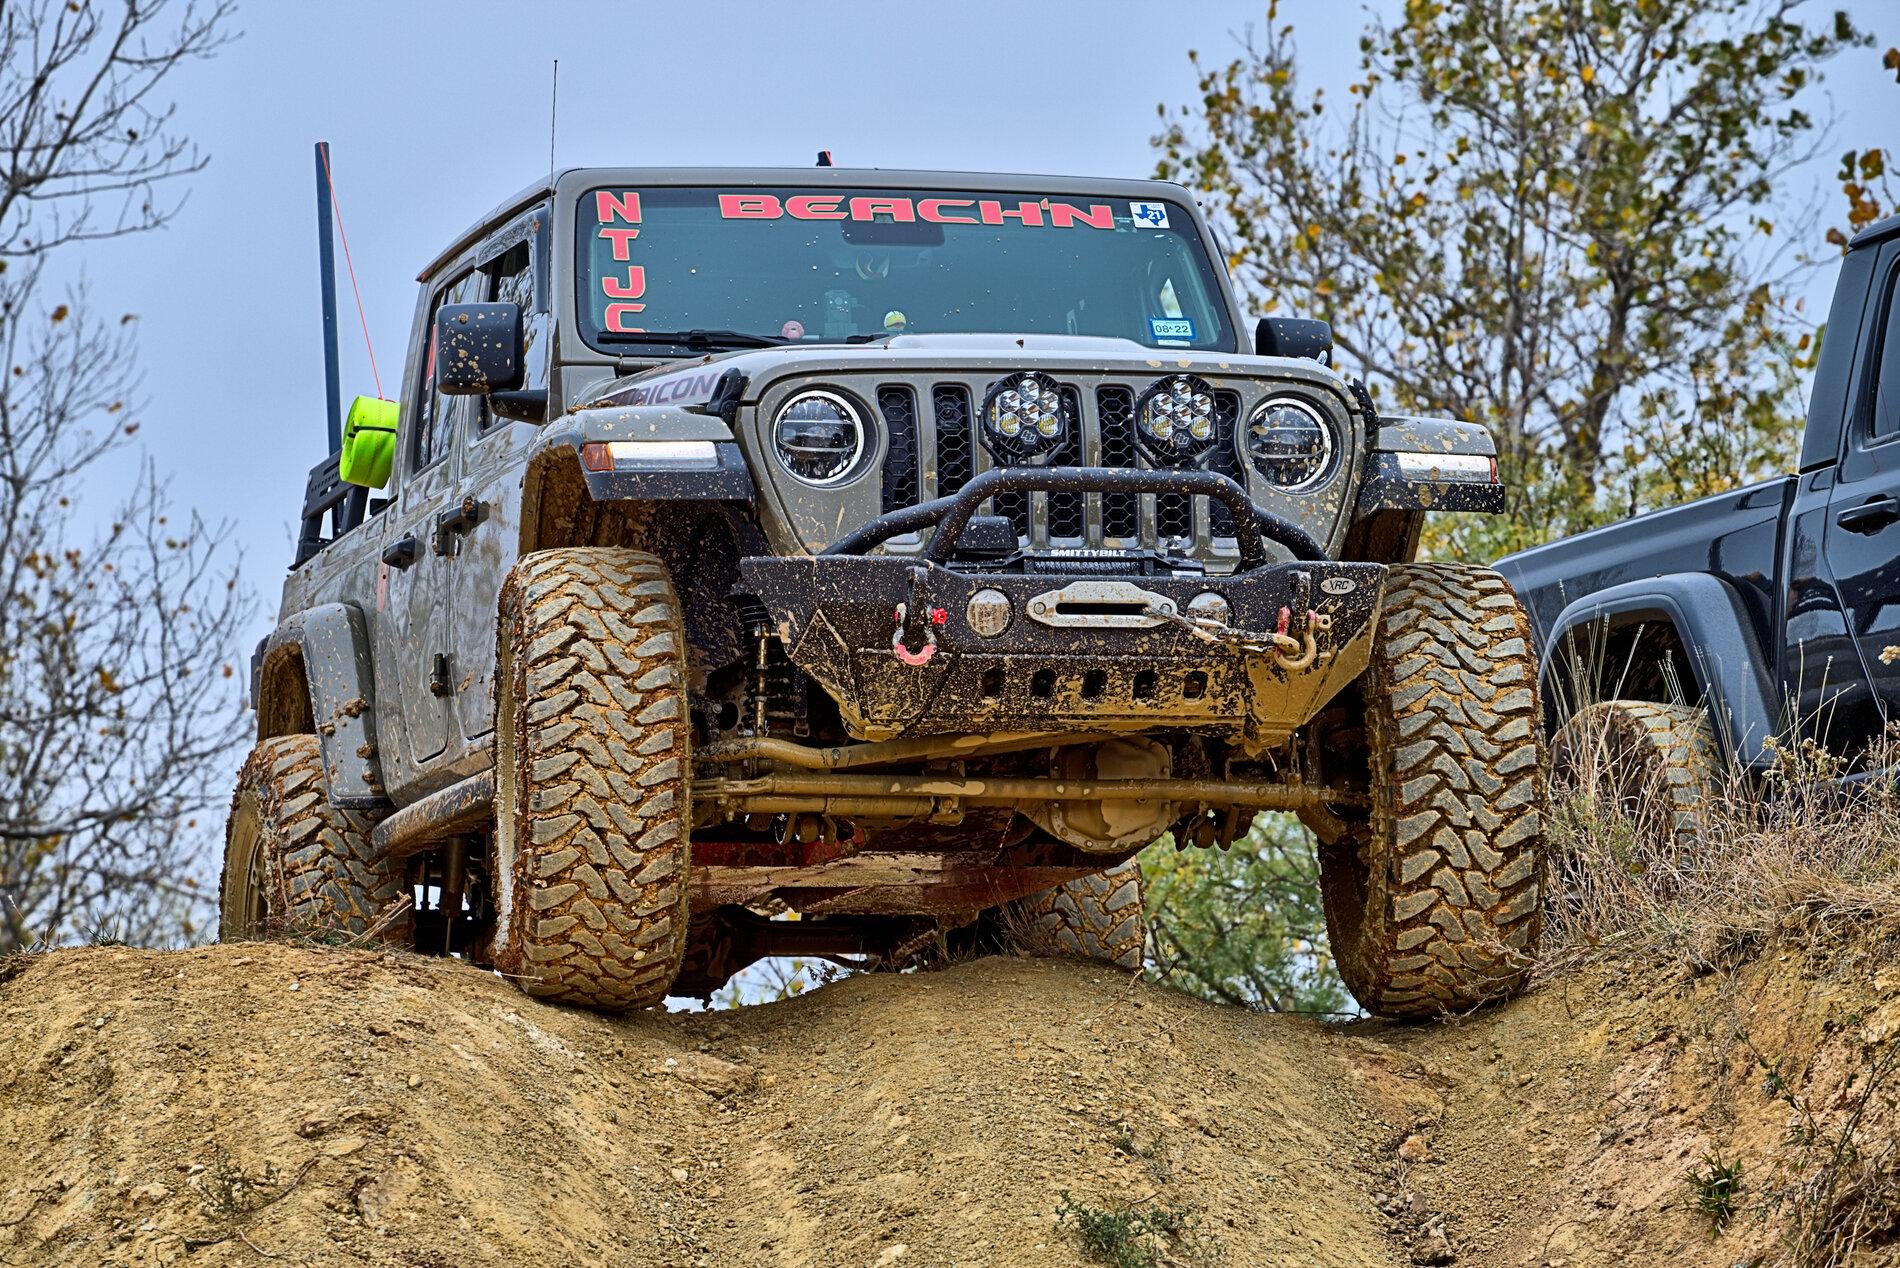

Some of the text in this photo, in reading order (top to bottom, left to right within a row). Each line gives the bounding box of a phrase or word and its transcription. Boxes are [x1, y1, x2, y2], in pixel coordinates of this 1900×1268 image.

[718, 194, 1115, 229] BEACH'N
[1147, 211, 1161, 219] 21
[596, 191, 646, 333] NTJC
[1050, 549, 1127, 557] SMITTYBILT
[1327, 580, 1349, 591] XRC
